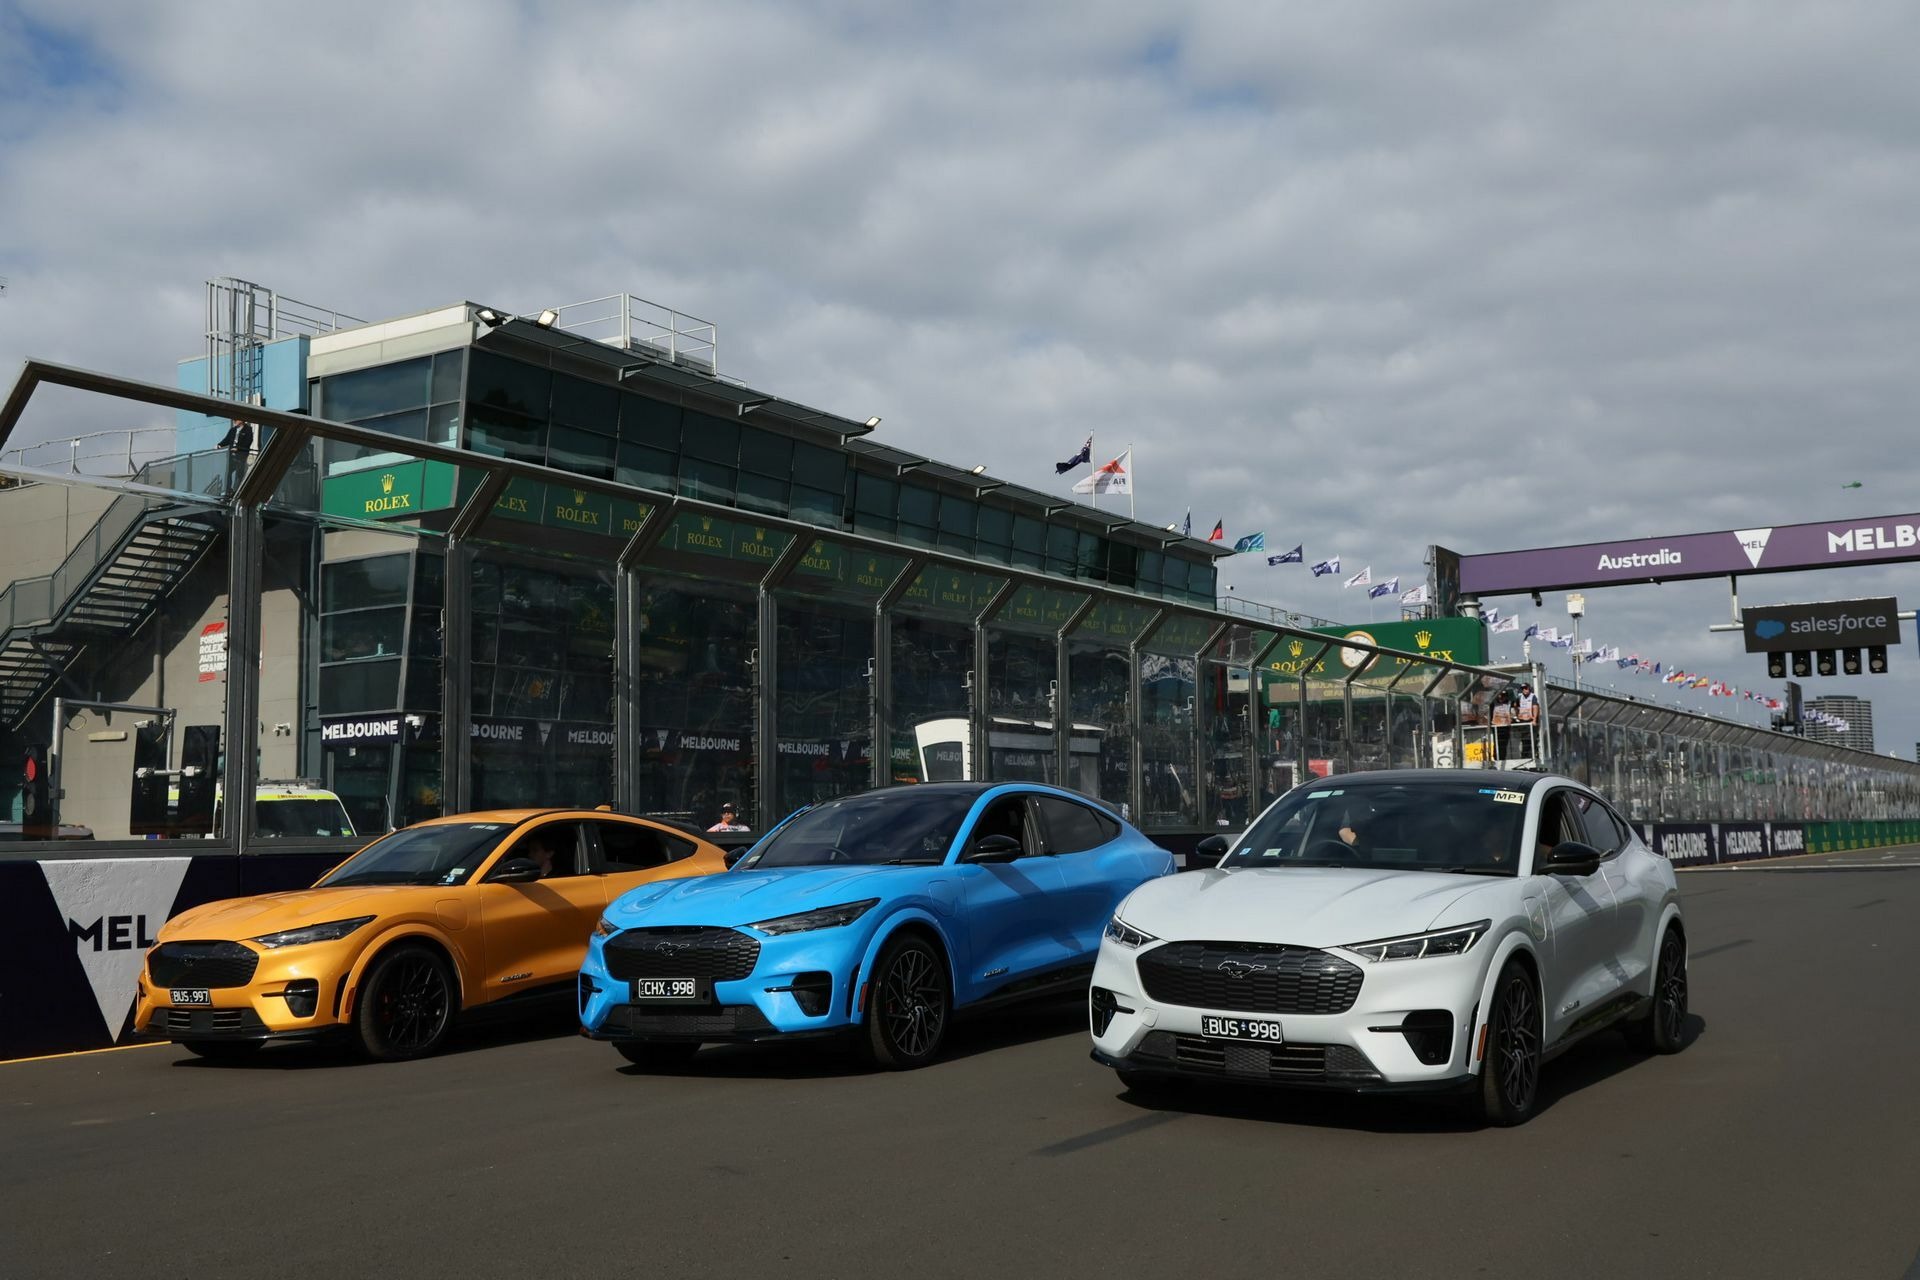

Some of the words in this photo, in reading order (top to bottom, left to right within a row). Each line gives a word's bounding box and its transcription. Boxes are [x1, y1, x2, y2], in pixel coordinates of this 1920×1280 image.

[365, 495, 410, 513] ROLEX
[498, 497, 527, 513] LEX
[556, 506, 599, 525] ROLEX
[687, 532, 723, 548] ROLEX
[1742, 540, 1764, 549] MEL
[1827, 524, 1920, 553] MELB
[741, 542, 775, 558] ROLEX
[1598, 548, 1682, 571] Australia
[1790, 614, 1887, 635] salesforce
[322, 719, 399, 740] MELBOURNE
[470, 723, 523, 741] BOURNE
[568, 730, 615, 745] MELBOU
[681, 736, 740, 751] MELBOURNE
[779, 743, 830, 756] MELBOURNE
[1496, 793, 1523, 801] MP1
[1661, 832, 1708, 859] MELBOURNE
[1725, 831, 1762, 855] MELBOURNE
[1773, 830, 1804, 850] MELBOURNE
[69, 914, 154, 952] MEL
[173, 990, 190, 1002] BUS
[192, 990, 208, 1002] 997
[644, 981, 666, 995] CHX
[672, 981, 694, 995] 998
[1209, 1018, 1239, 1036] BUS
[1248, 1022, 1280, 1040] 998
